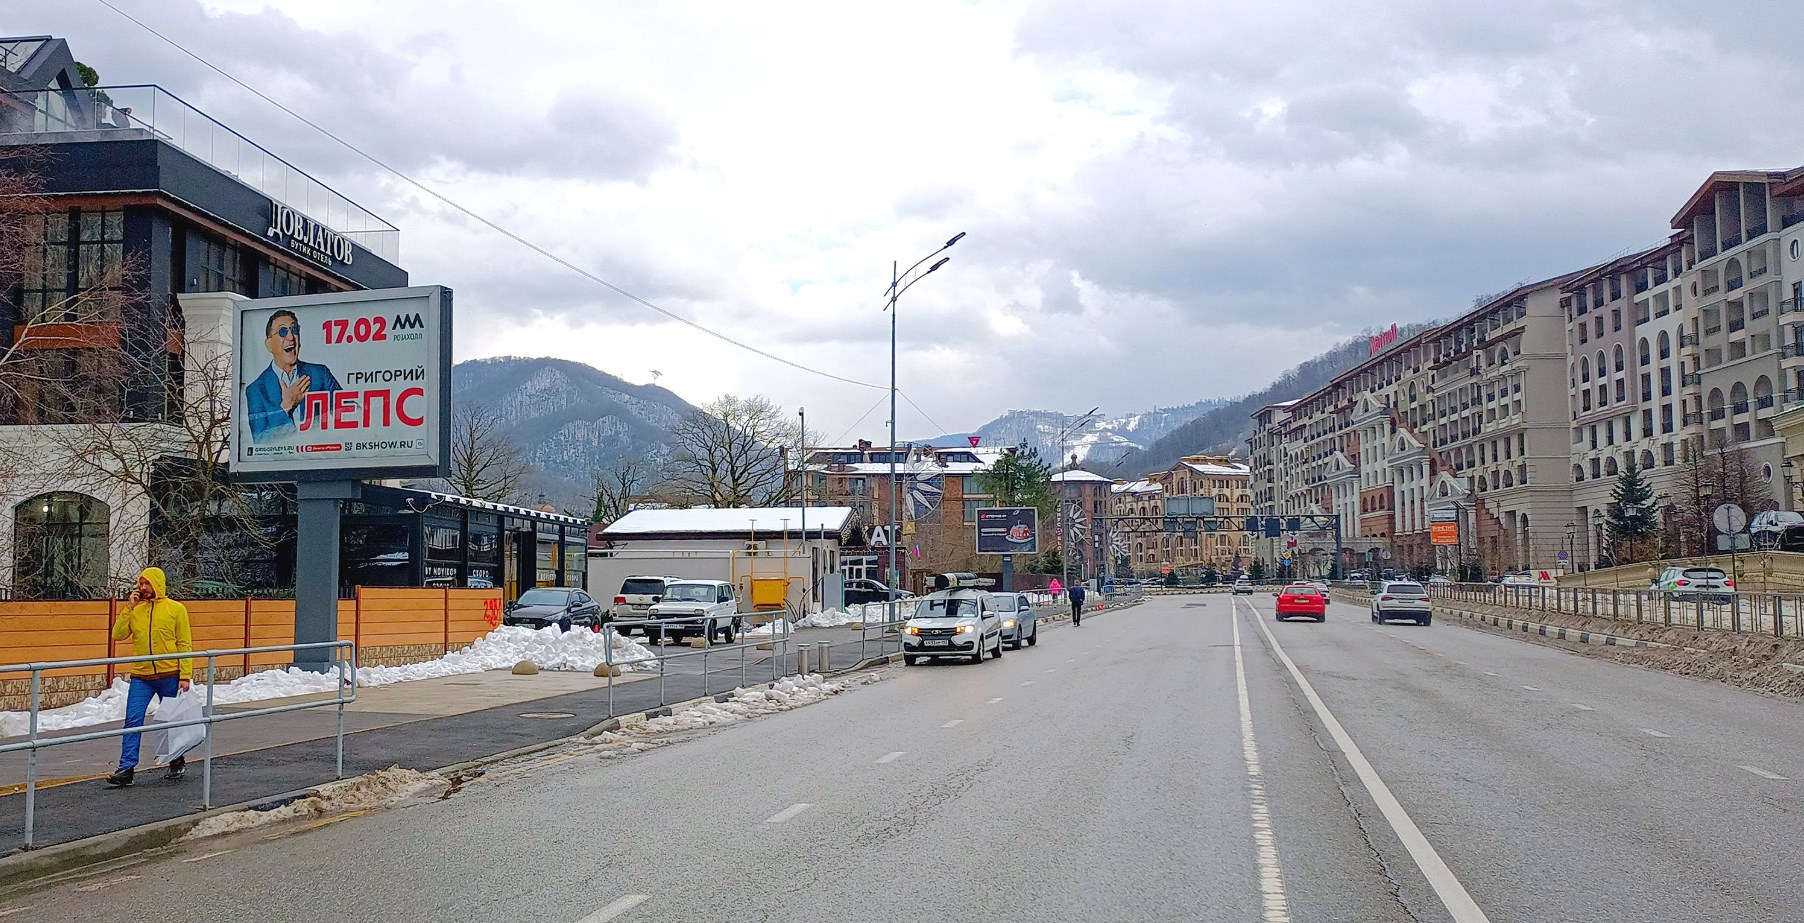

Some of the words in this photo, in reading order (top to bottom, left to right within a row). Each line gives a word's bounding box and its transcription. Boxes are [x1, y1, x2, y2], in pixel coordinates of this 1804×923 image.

[267, 201, 353, 265] ДОВЛАТОВ
[290, 240, 311, 256] БУТИК
[312, 250, 332, 266] ОТЕЛЬ
[322, 316, 387, 345] 17.02
[347, 365, 425, 384] ГРИГОРИЙ
[299, 387, 424, 431] ЛЕПС
[355, 440, 414, 451] BKSHOW.RU
